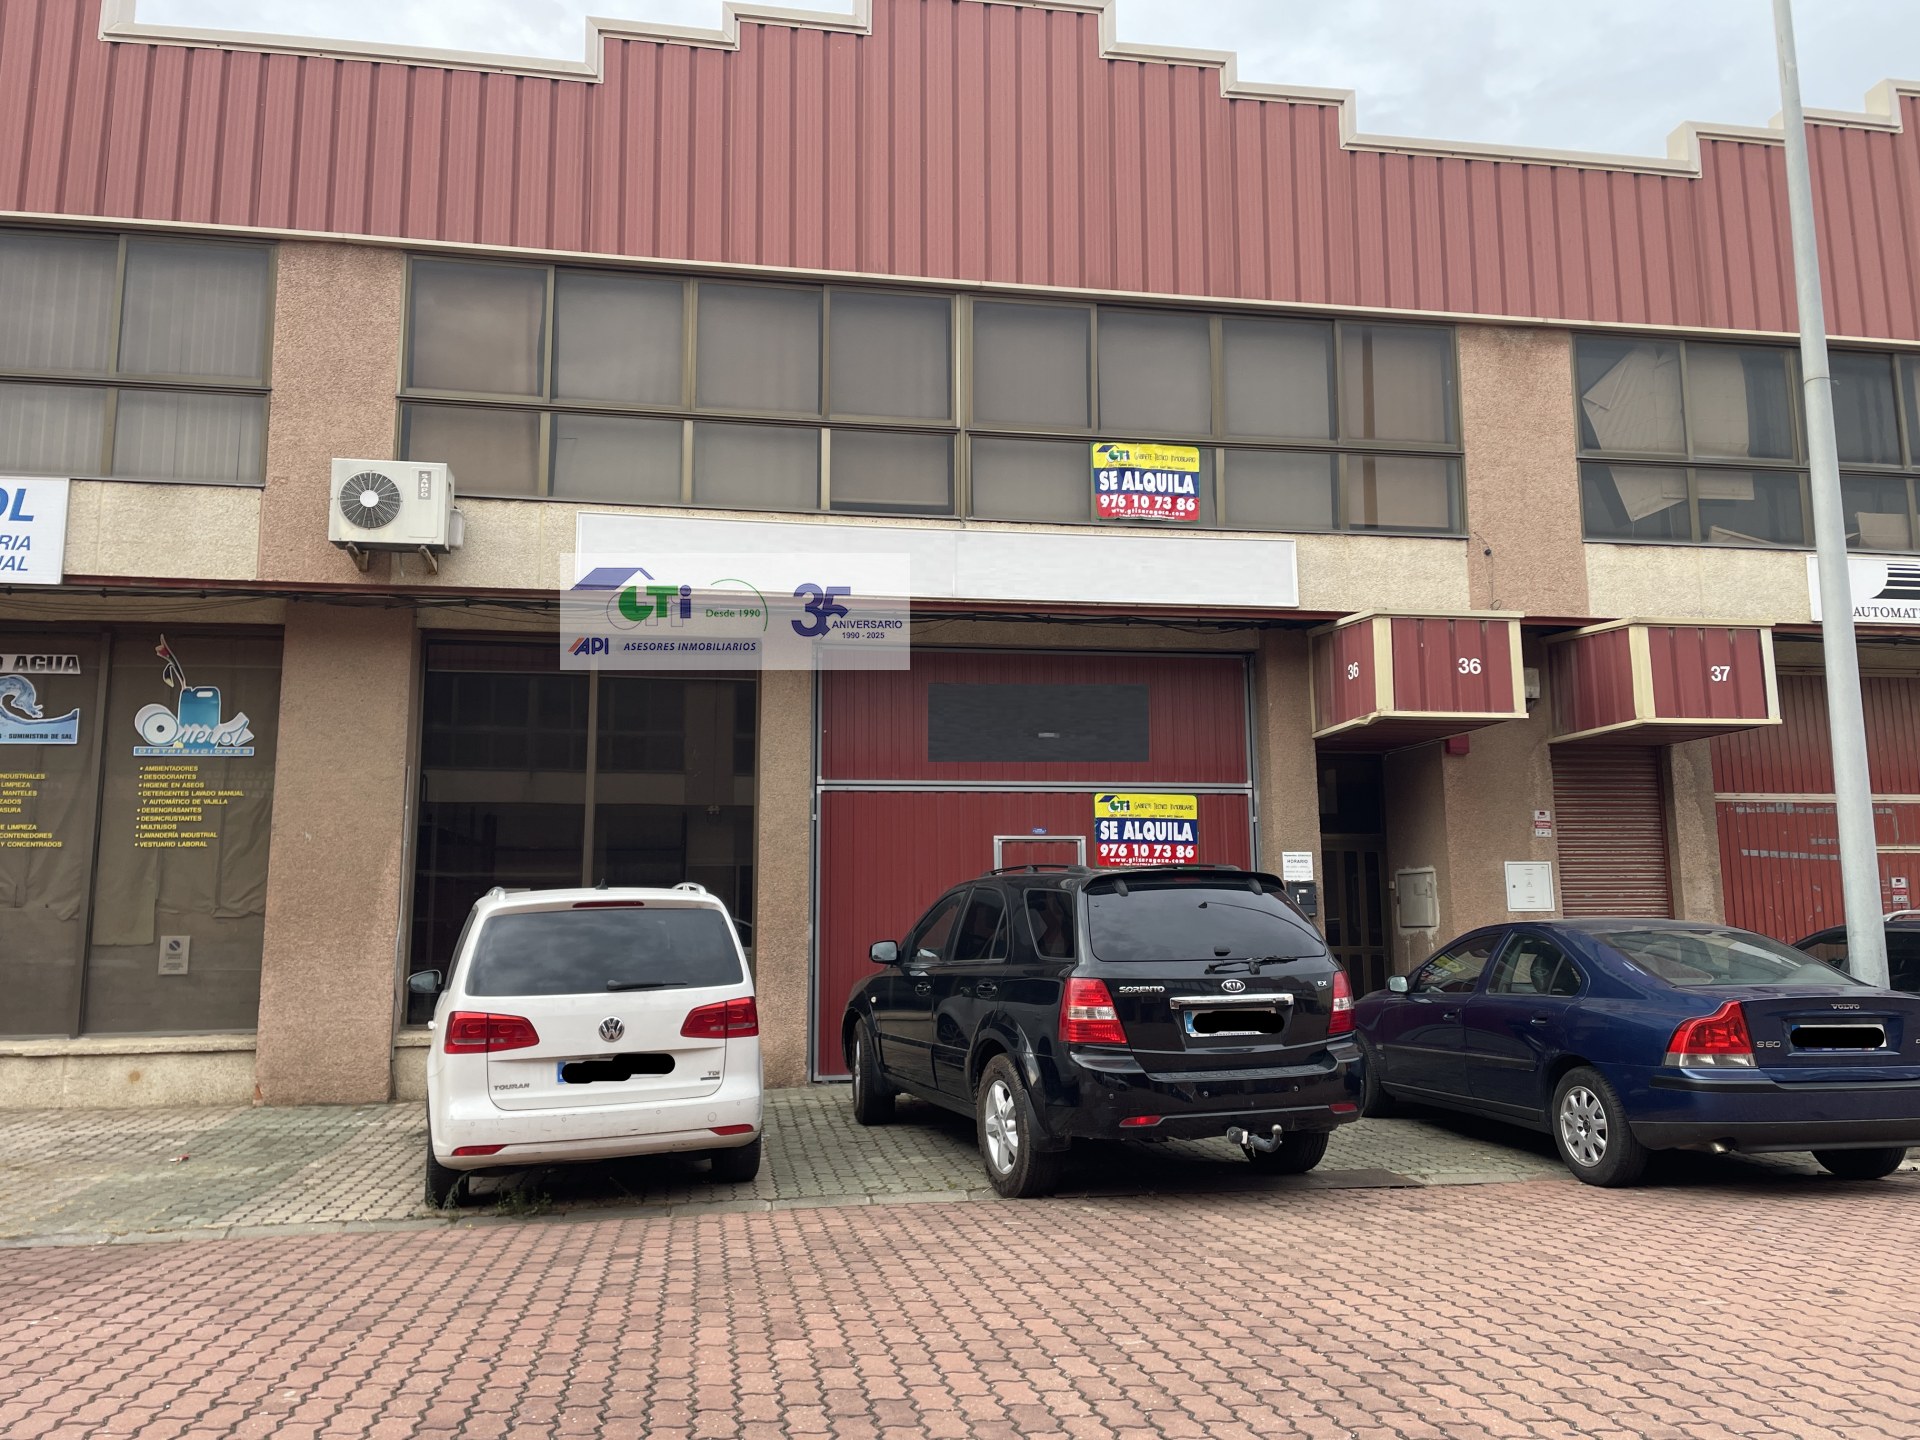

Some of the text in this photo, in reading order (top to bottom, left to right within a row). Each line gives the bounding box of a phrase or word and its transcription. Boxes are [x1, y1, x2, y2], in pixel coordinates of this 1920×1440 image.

[420, 473, 429, 498] SAMPO
[1099, 470, 1195, 494] SE ALQUILA
[0, 487, 34, 522] L
[1100, 494, 1196, 511] 976 10 73 86
[12, 655, 79, 672] AGUA
[1347, 661, 1359, 680] 36
[1457, 657, 1482, 675] 36
[1710, 665, 1731, 682] 37
[1100, 820, 1193, 842] SE ALQUILA
[1100, 844, 1194, 858] 976 10 73 86
[1317, 980, 1328, 988] EX
[493, 1082, 530, 1091] TOURAN
